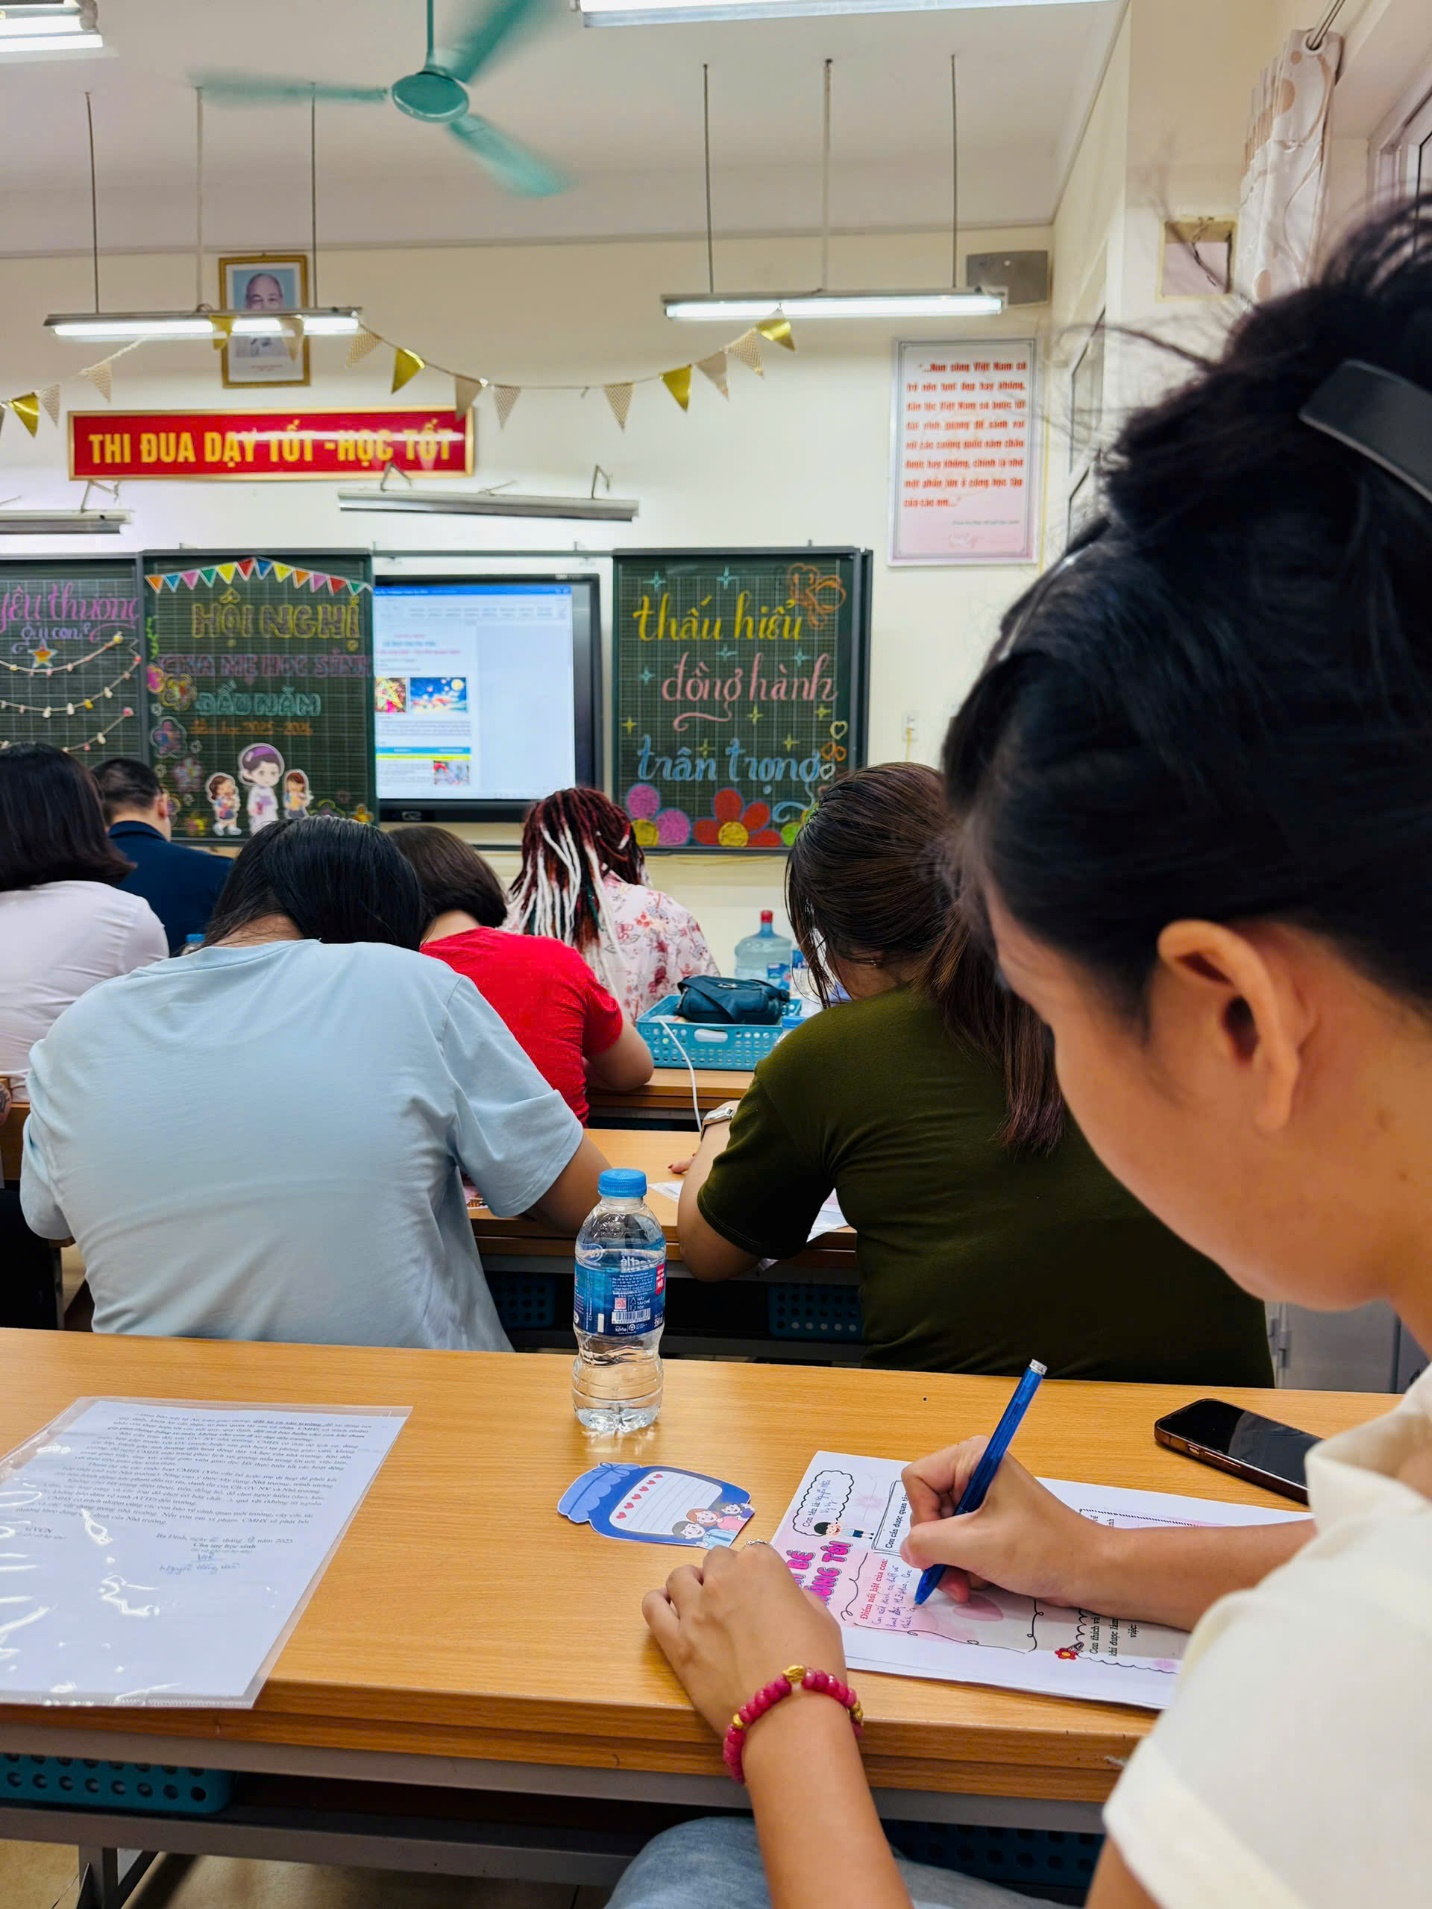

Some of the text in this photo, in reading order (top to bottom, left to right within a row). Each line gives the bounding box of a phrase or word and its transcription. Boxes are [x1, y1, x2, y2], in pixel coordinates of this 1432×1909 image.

[973, 362, 989, 371] Việt
[993, 362, 1012, 370] Nam
[89, 434, 131, 463] THI
[140, 433, 196, 463] ĐUA
[205, 431, 255, 467] DẠY
[269, 419, 314, 462] TỐT
[405, 418, 454, 461] TỐT
[191, 587, 360, 651] HỘI NGHỊ
[632, 591, 802, 641] thấu hiểu
[194, 679, 322, 716] ĐẦU NĂM
[661, 652, 839, 731] đồng hành
[637, 734, 820, 822] trân trọng
[898, 1503, 907, 1514] quan
[802, 1517, 813, 1528] Con
[893, 1516, 903, 1527] được
[889, 1529, 898, 1537] cần
[885, 1539, 895, 1548] Con
[820, 1541, 853, 1562] TÔI
[786, 1550, 816, 1570] BÉ
[860, 1559, 888, 1620] Điểm nổi bật của con:
[1090, 1626, 1099, 1641] thích
[1128, 1624, 1139, 1637] việc:
[1110, 1631, 1120, 1646] được
[1089, 1643, 1098, 1654] Con
[1109, 1647, 1117, 1656] khi
